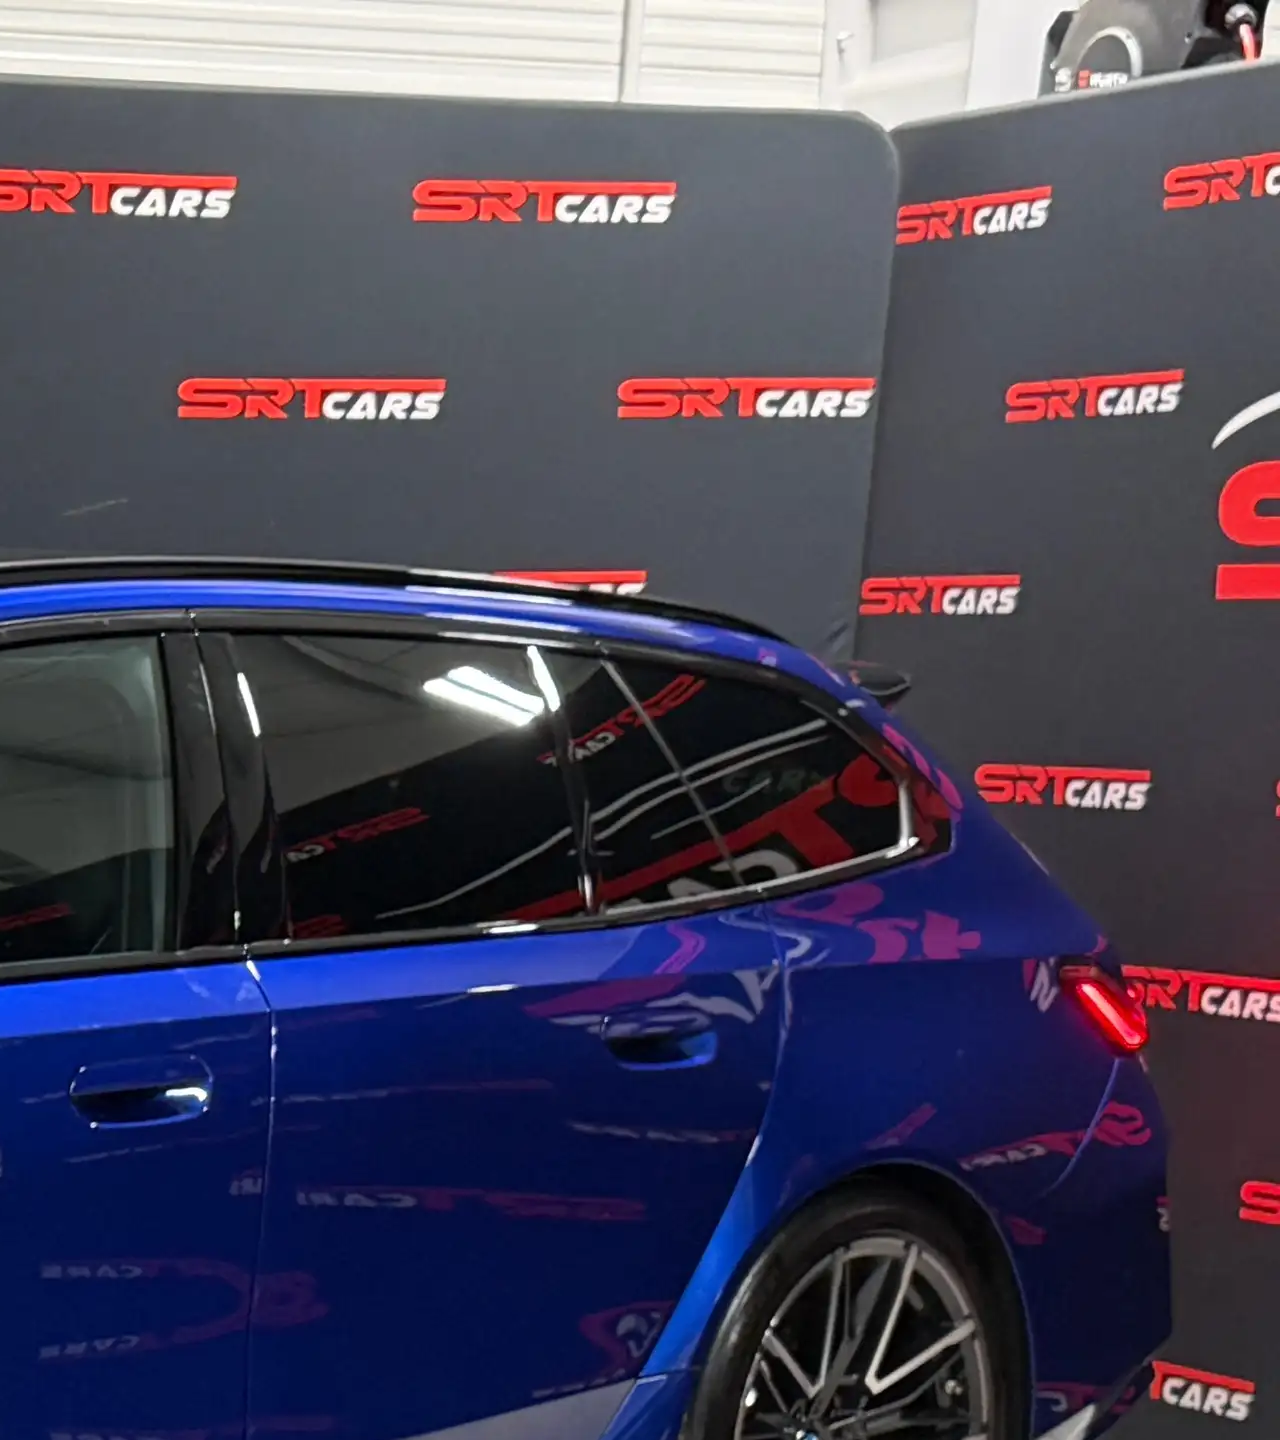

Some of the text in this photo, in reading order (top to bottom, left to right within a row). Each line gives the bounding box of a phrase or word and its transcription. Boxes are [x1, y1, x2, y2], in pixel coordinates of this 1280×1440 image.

[111, 187, 235, 218] CARS
[555, 195, 675, 223] CARS
[973, 199, 1052, 235] CARS
[323, 392, 444, 419] CARS
[756, 389, 874, 417] CARS
[1098, 383, 1182, 416] CARS
[943, 588, 1020, 614] CARS
[1066, 781, 1149, 809] CARS
[1164, 1379, 1251, 1420] CARS
